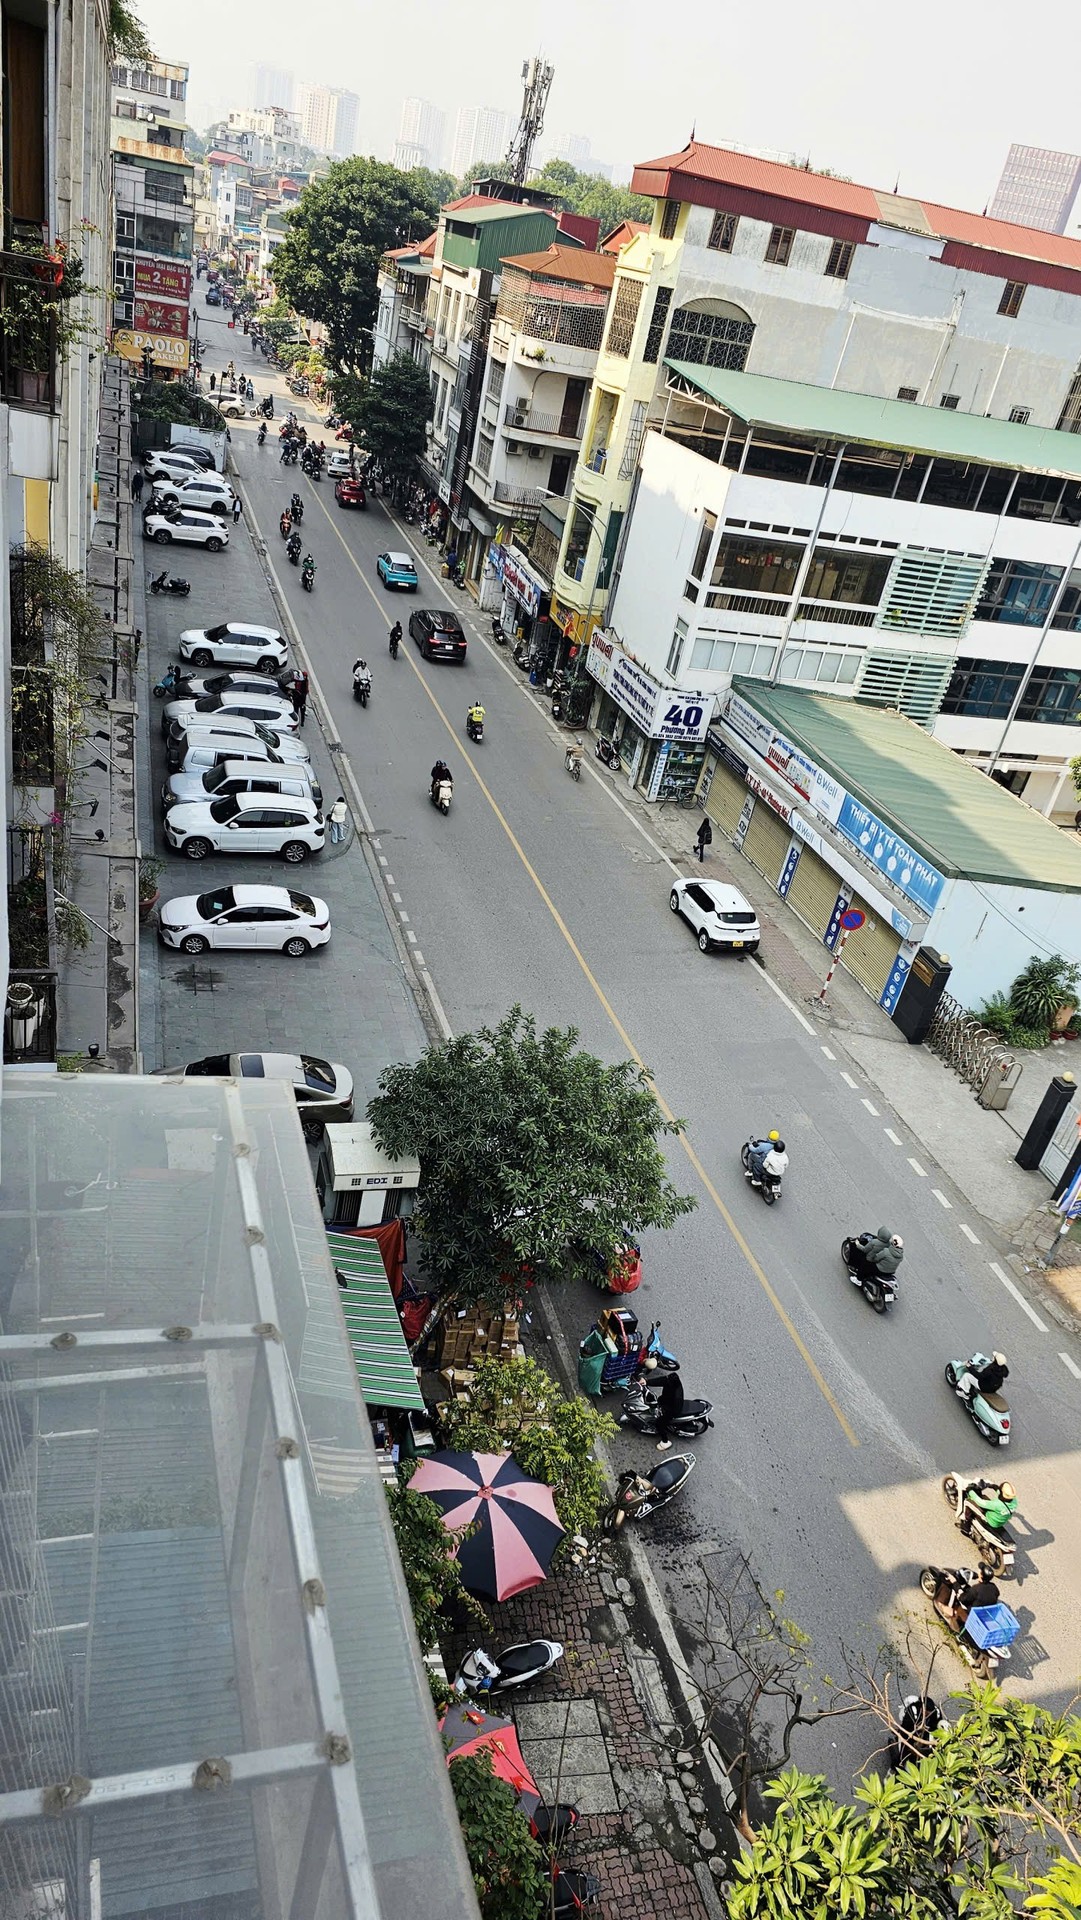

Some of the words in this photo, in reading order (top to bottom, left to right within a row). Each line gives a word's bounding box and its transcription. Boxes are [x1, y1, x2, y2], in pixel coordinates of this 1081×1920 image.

[137, 272, 151, 282] MUA
[152, 271, 161, 284] 2
[162, 276, 179, 287] TẶNG
[181, 276, 187, 289] 1
[133, 334, 185, 356] PAOLO
[151, 352, 185, 363] BAKERY
[664, 704, 704, 728] 40
[660, 725, 686, 736] Phương
[686, 727, 700, 736] Mai
[768, 745, 790, 770] yuwell
[816, 773, 838, 799] B.Well
[795, 820, 814, 843] B.Well
[850, 803, 871, 827] THIẾT
[869, 821, 879, 837] BỊ
[878, 828, 885, 838] Y
[884, 834, 897, 850] TẾ
[894, 842, 916, 868] TOÀN
[915, 862, 939, 887] PHÁT
